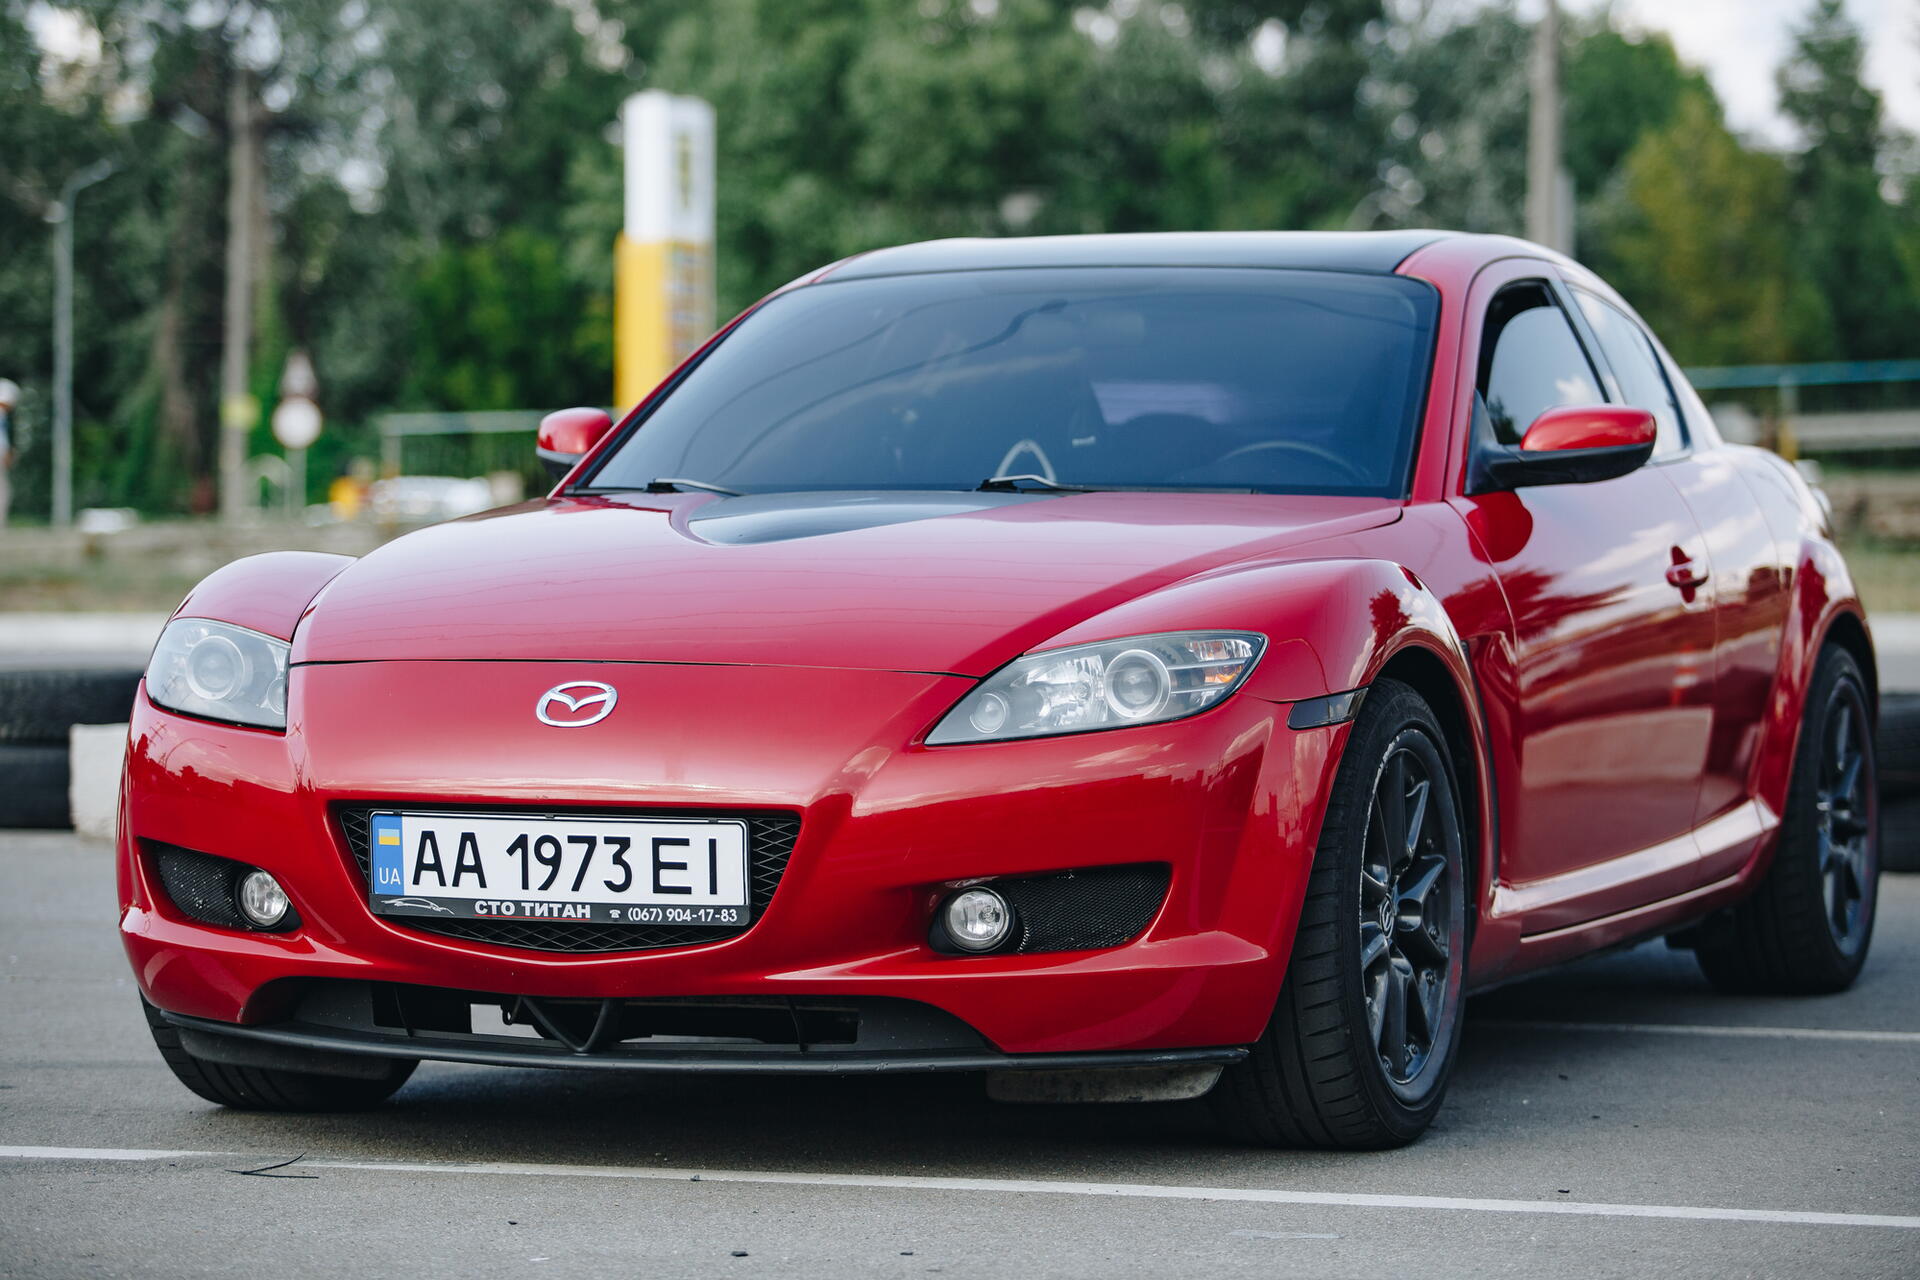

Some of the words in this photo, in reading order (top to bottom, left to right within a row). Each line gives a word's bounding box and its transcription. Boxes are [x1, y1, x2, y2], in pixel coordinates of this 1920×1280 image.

[412, 830, 488, 889] AA
[506, 833, 633, 894] 1973
[651, 836, 719, 896] EI
[379, 867, 401, 885] UA
[474, 901, 515, 916] СТО
[521, 902, 591, 919] ТИТАН
[627, 908, 662, 922] (067)
[666, 908, 738, 922] 904-17-83
